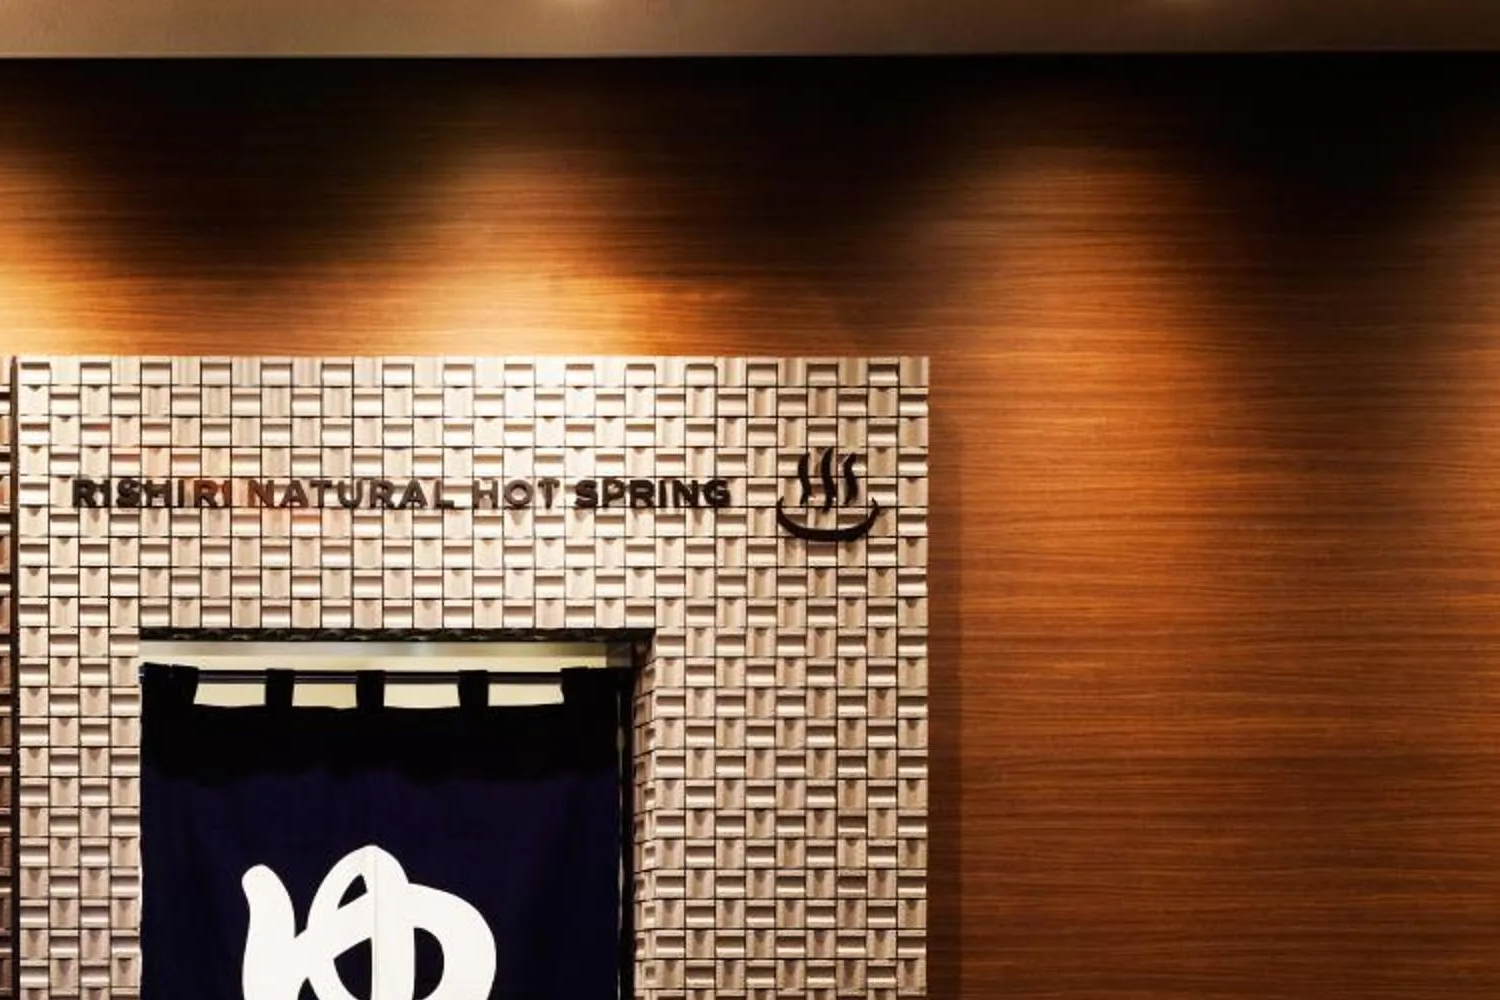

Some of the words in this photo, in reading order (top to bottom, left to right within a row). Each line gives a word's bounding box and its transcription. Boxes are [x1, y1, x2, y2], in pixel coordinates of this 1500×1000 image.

[73, 479, 232, 509] RISHIRI
[248, 479, 455, 509] NATURAL
[472, 479, 560, 509] HOT
[574, 479, 731, 509] SPRING
